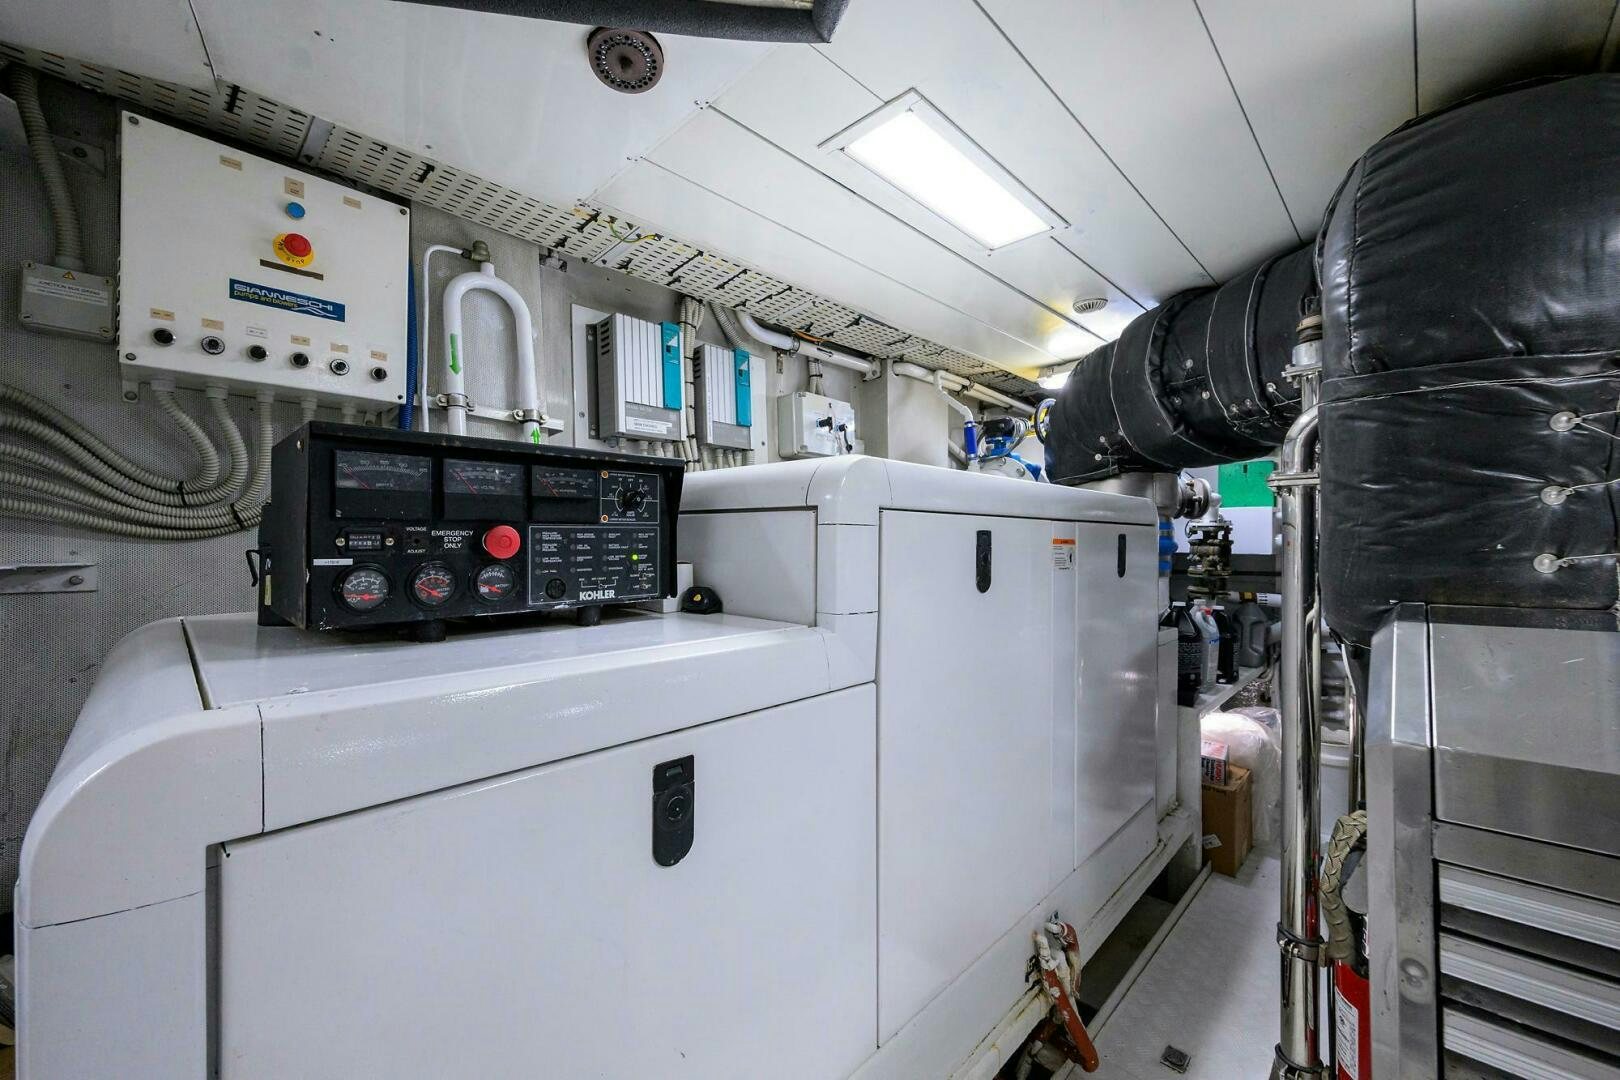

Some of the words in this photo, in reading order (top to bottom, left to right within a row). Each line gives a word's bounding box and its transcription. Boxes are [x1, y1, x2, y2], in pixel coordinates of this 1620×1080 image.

[233, 283, 333, 312] GIANNESCHI
[234, 290, 259, 300] pumps
[272, 296, 299, 308] blowers
[579, 589, 615, 601] KOHLER
